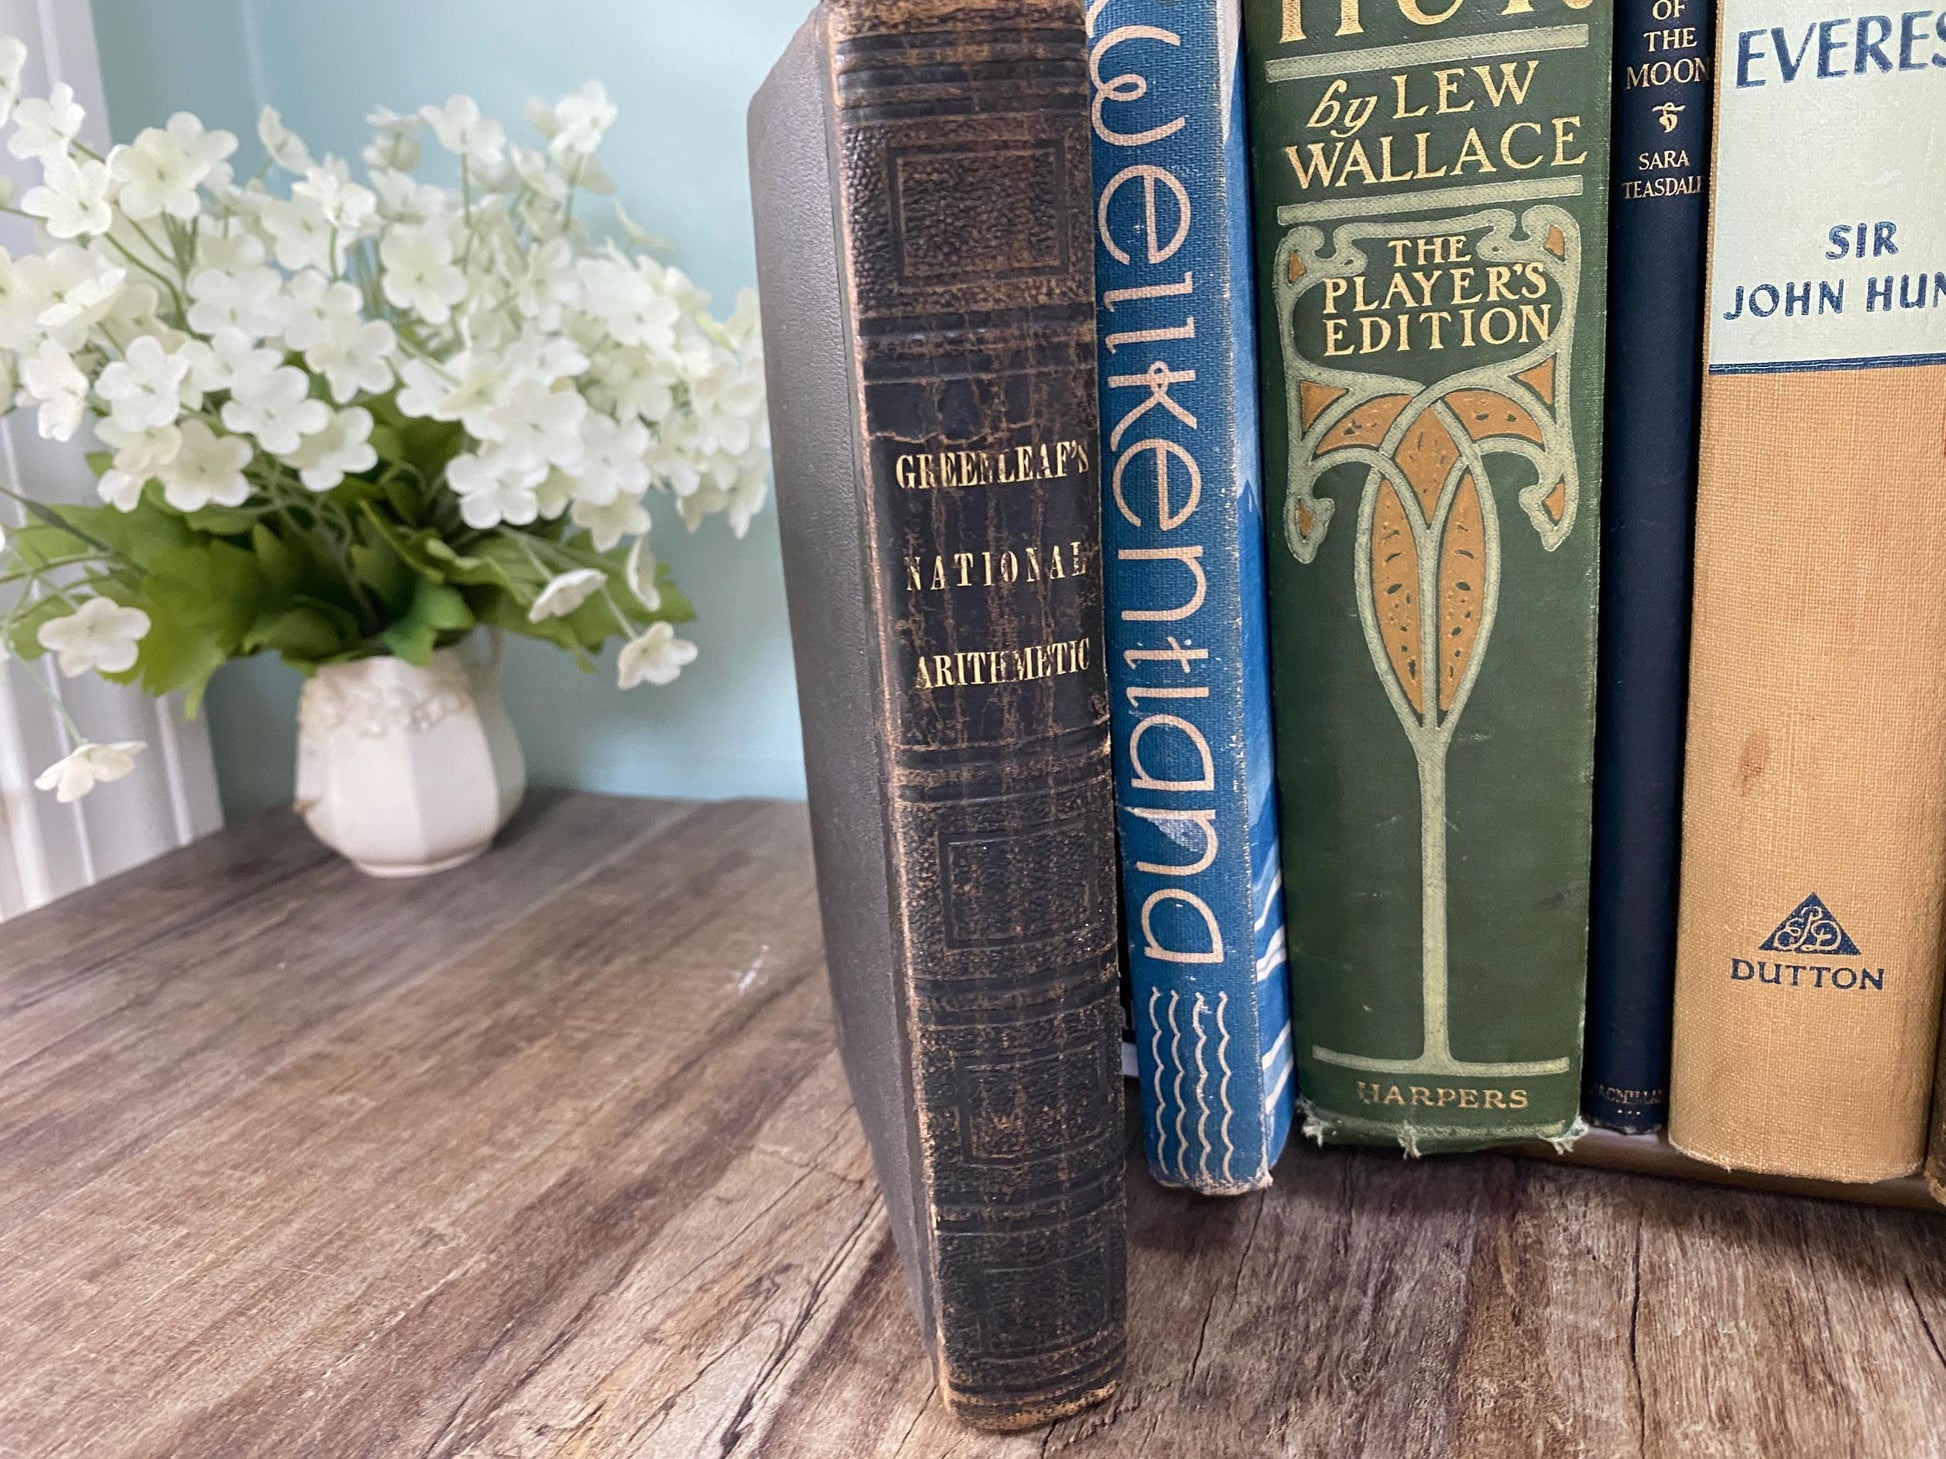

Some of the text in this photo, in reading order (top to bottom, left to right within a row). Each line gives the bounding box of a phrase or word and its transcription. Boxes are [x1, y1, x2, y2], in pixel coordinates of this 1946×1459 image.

[1652, 0, 1686, 20] OF
[1643, 28, 1698, 52] THE
[1626, 57, 1712, 90] MOON
[1307, 60, 1539, 138] by LEW
[1284, 116, 1588, 190] WALLACE
[1638, 149, 1690, 171] SARA
[1388, 234, 1472, 265] THE
[1825, 221, 1899, 260] SIR
[1322, 261, 1548, 315] PLAYER'S
[1722, 278, 1845, 321] JOHN
[1323, 303, 1553, 358] EDITION
[904, 541, 1088, 591] NATIONAL
[915, 637, 1091, 690] ARITHMETIC
[1731, 957, 1885, 991] DUTTON
[1357, 1080, 1529, 1109] HARPERS
